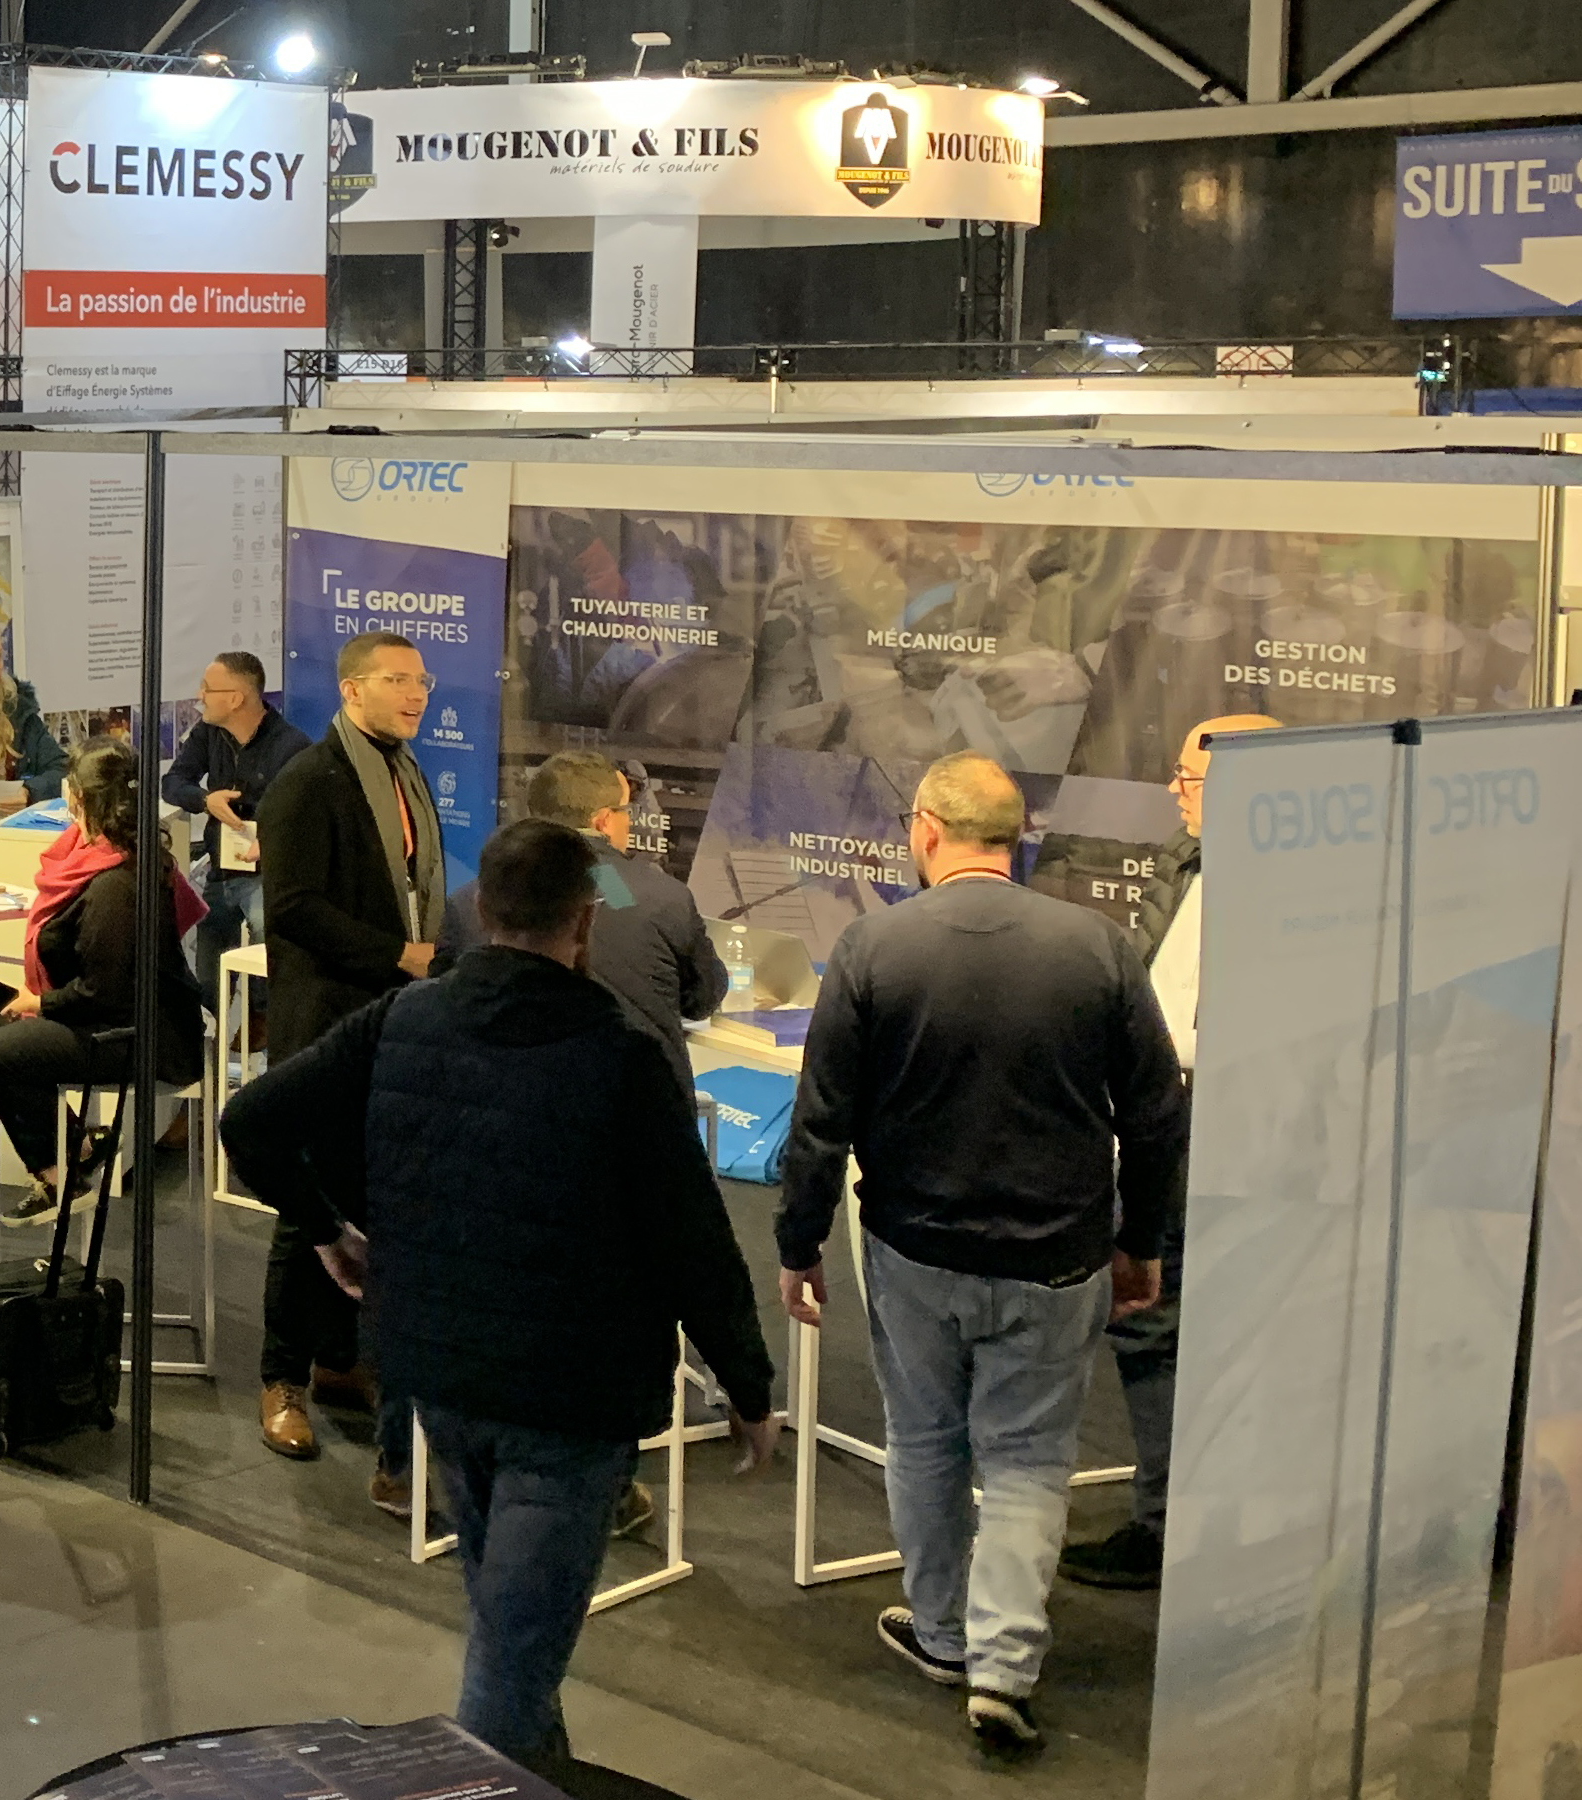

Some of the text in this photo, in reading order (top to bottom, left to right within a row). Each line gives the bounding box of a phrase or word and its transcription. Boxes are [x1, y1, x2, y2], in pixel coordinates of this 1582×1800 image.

[396, 127, 759, 163] MOUGENOT & FILS
[49, 141, 305, 201] CLEMESSY
[550, 156, 719, 175] matériels de soudure
[1402, 159, 1547, 219] SUITE
[1548, 173, 1573, 194] DU
[46, 285, 307, 321] La passion de l'industrie
[46, 363, 157, 379] Clemessy est la marque
[46, 383, 173, 400] d'Eiffage Énergie Systèmes
[379, 460, 468, 493] ORTEC
[335, 588, 465, 617] LE GROUPE
[570, 597, 709, 622] TUYAUTERIE ET
[335, 615, 469, 644] EN CHIFFRES
[561, 619, 719, 646] CHAUDRONNERIE
[867, 627, 997, 654] MÉCANIQUE
[1254, 639, 1366, 665] GESTION
[1224, 664, 1397, 695] DES DÉCHETS
[789, 831, 909, 862] NETTOYAGE
[789, 855, 909, 887] INDUSTRIEL
[1091, 880, 1147, 904] ET R
